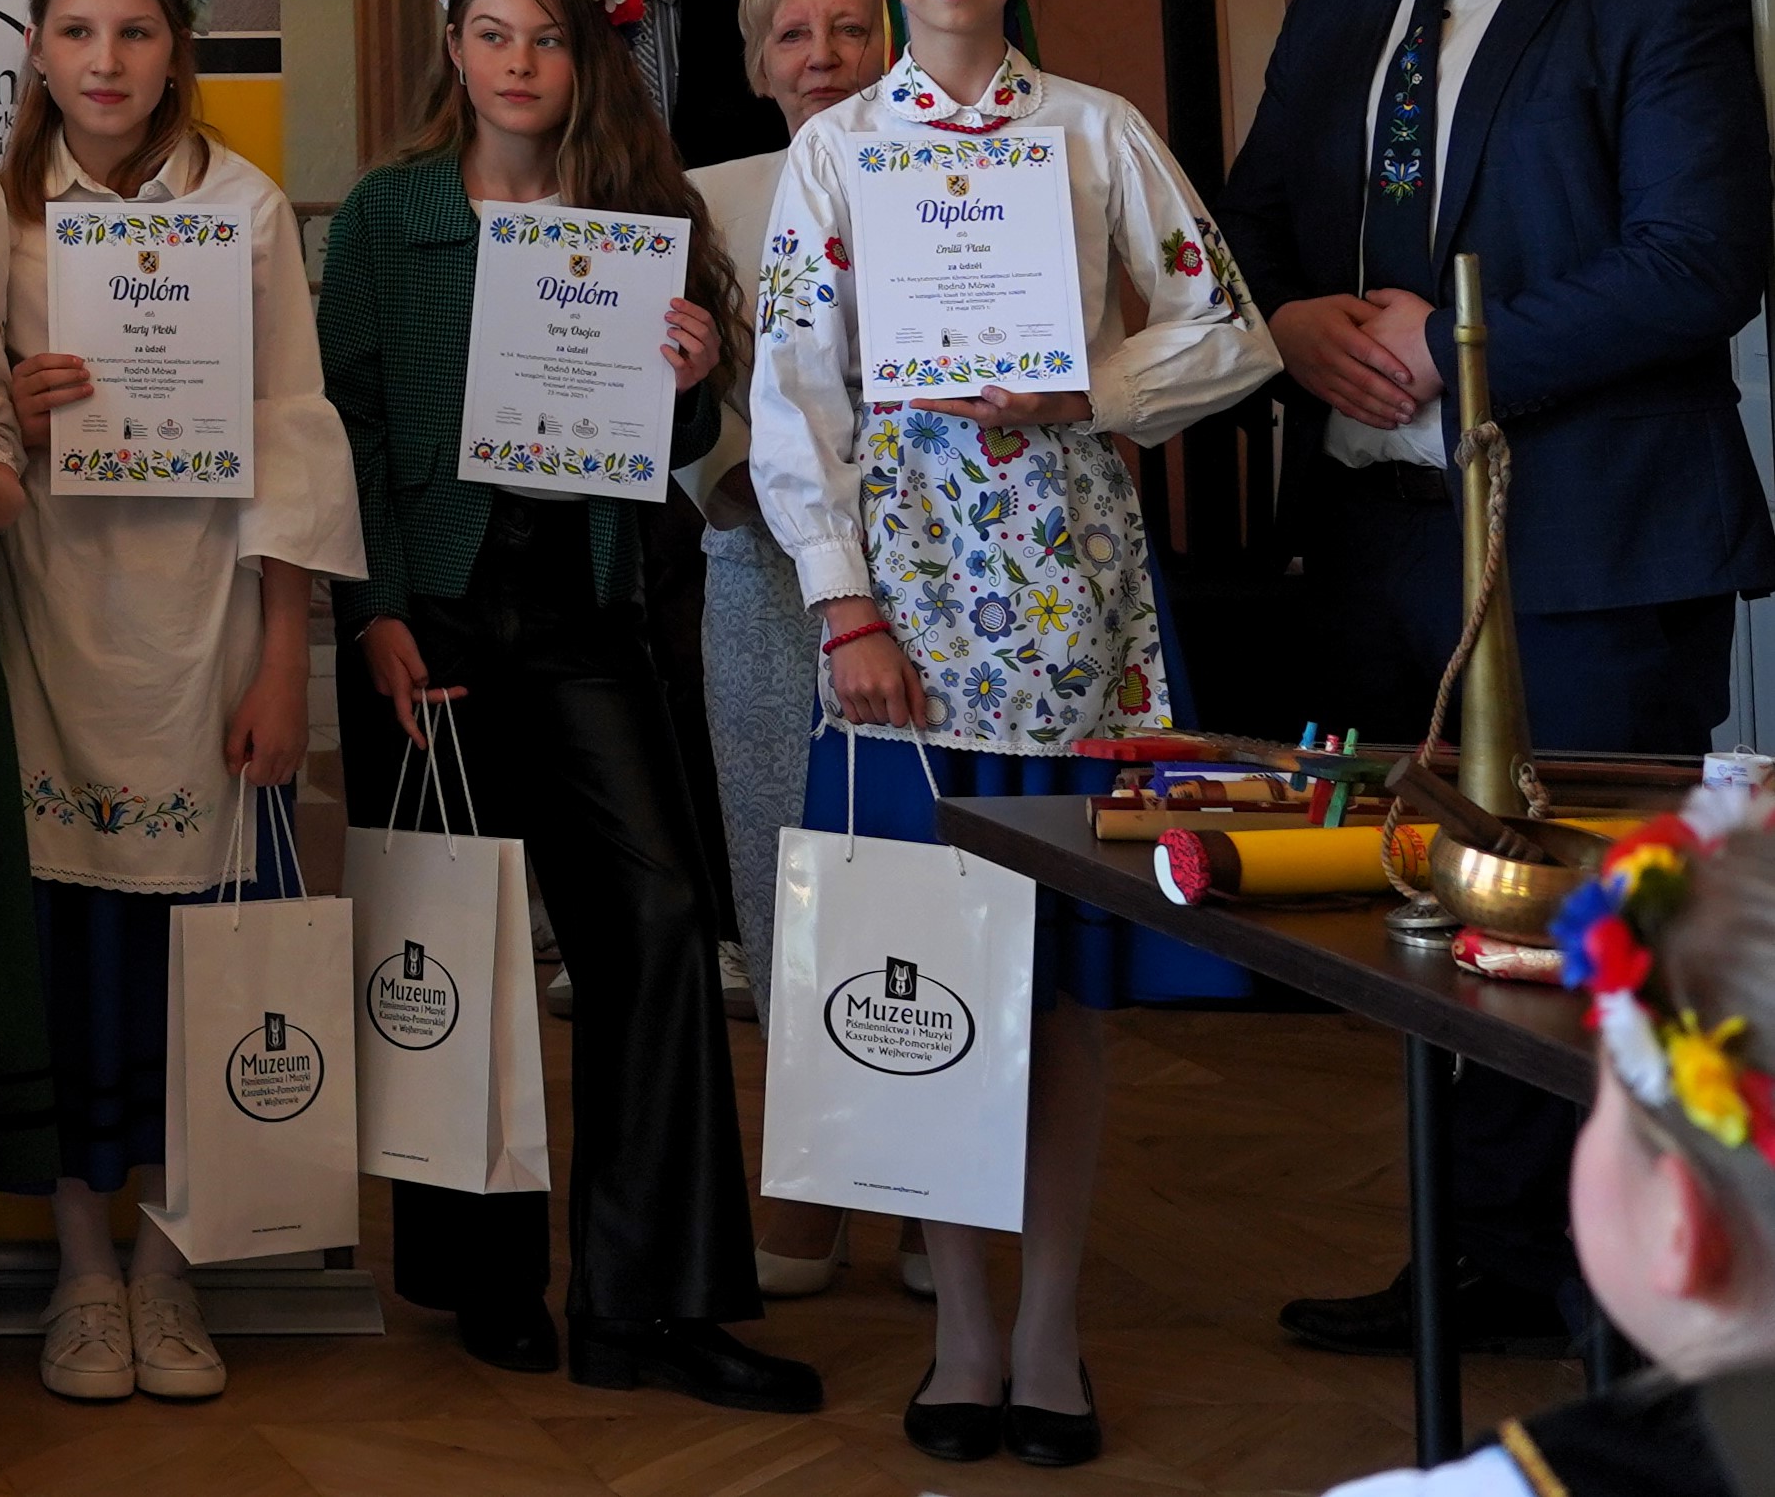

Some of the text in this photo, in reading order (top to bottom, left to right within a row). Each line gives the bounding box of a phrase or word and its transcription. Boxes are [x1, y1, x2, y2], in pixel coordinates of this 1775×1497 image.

[916, 198, 1004, 229] Diplóm
[109, 276, 189, 307] Diplóm
[537, 276, 618, 309] Diplóm
[123, 324, 149, 336] Marty
[380, 976, 446, 1006] Muzeum
[847, 994, 952, 1029] Muzeum
[846, 1030, 952, 1053] Kaszubsko-Pomorskiej
[918, 1028, 952, 1041] Muzyki
[240, 1053, 310, 1077] Muzeum
[879, 1046, 932, 1062] Wejherowie
